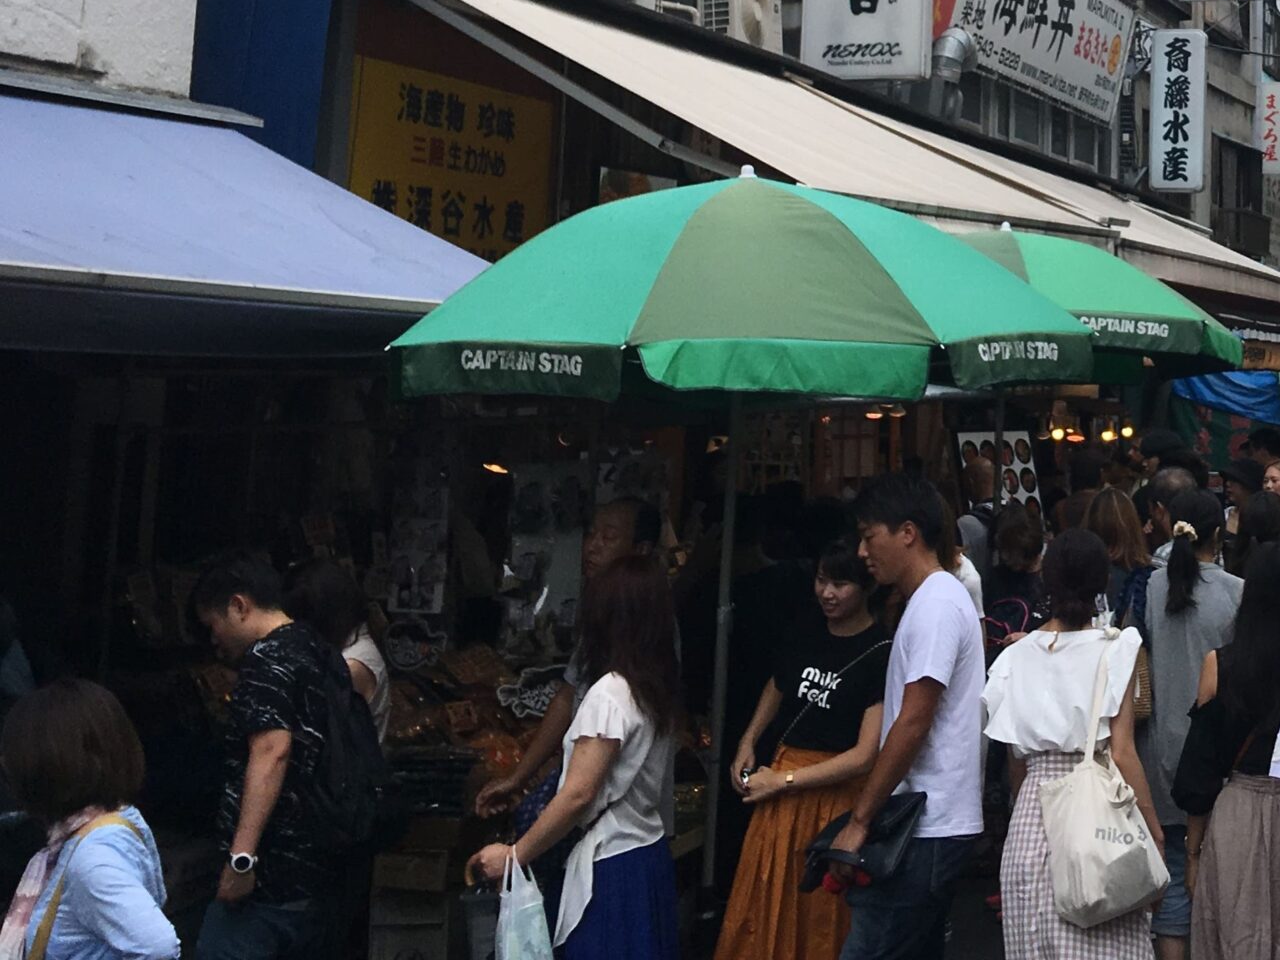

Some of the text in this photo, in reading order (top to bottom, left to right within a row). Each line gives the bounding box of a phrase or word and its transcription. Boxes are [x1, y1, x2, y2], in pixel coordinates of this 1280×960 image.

[1073, 20, 1109, 69] まるきた
[1262, 93, 1279, 162] まぐろ屋
[1079, 316, 1169, 338] CAPTAIN STAG
[461, 349, 583, 376] CAPTAIN STAG
[1026, 342, 1059, 362] STAG
[1094, 826, 1134, 845] niko
